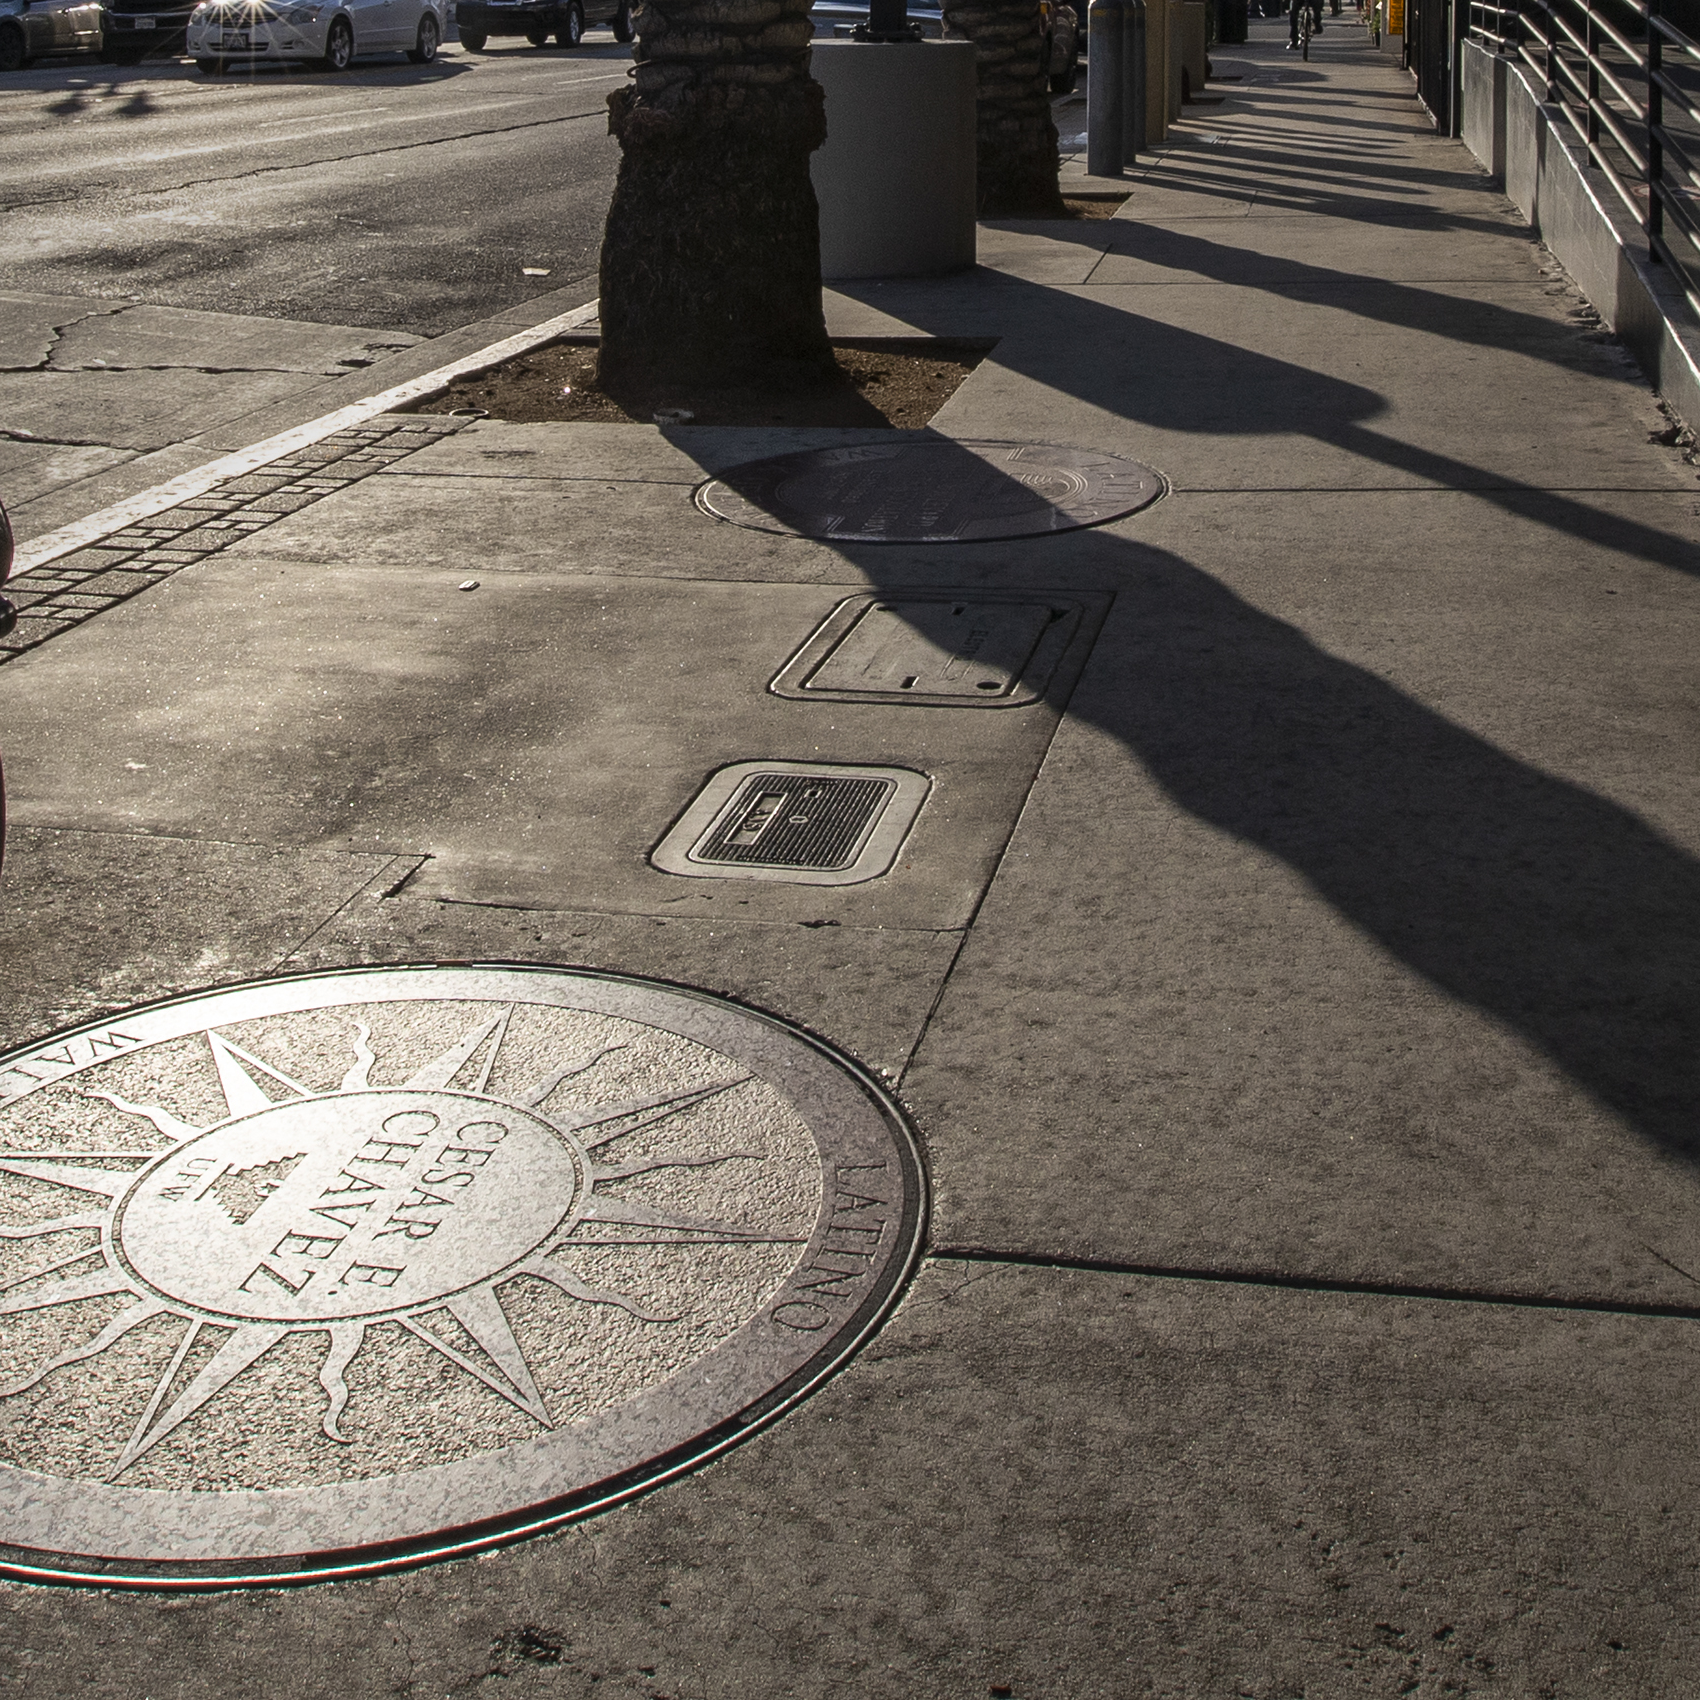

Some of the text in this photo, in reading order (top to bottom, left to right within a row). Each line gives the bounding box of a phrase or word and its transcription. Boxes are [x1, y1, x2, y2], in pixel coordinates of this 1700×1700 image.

[158, 1157, 217, 1204] UFW
[236, 1110, 441, 1298] CHAVEZ
[328, 1121, 509, 1296] CESAR E.
[770, 1161, 890, 1331] LATINO
